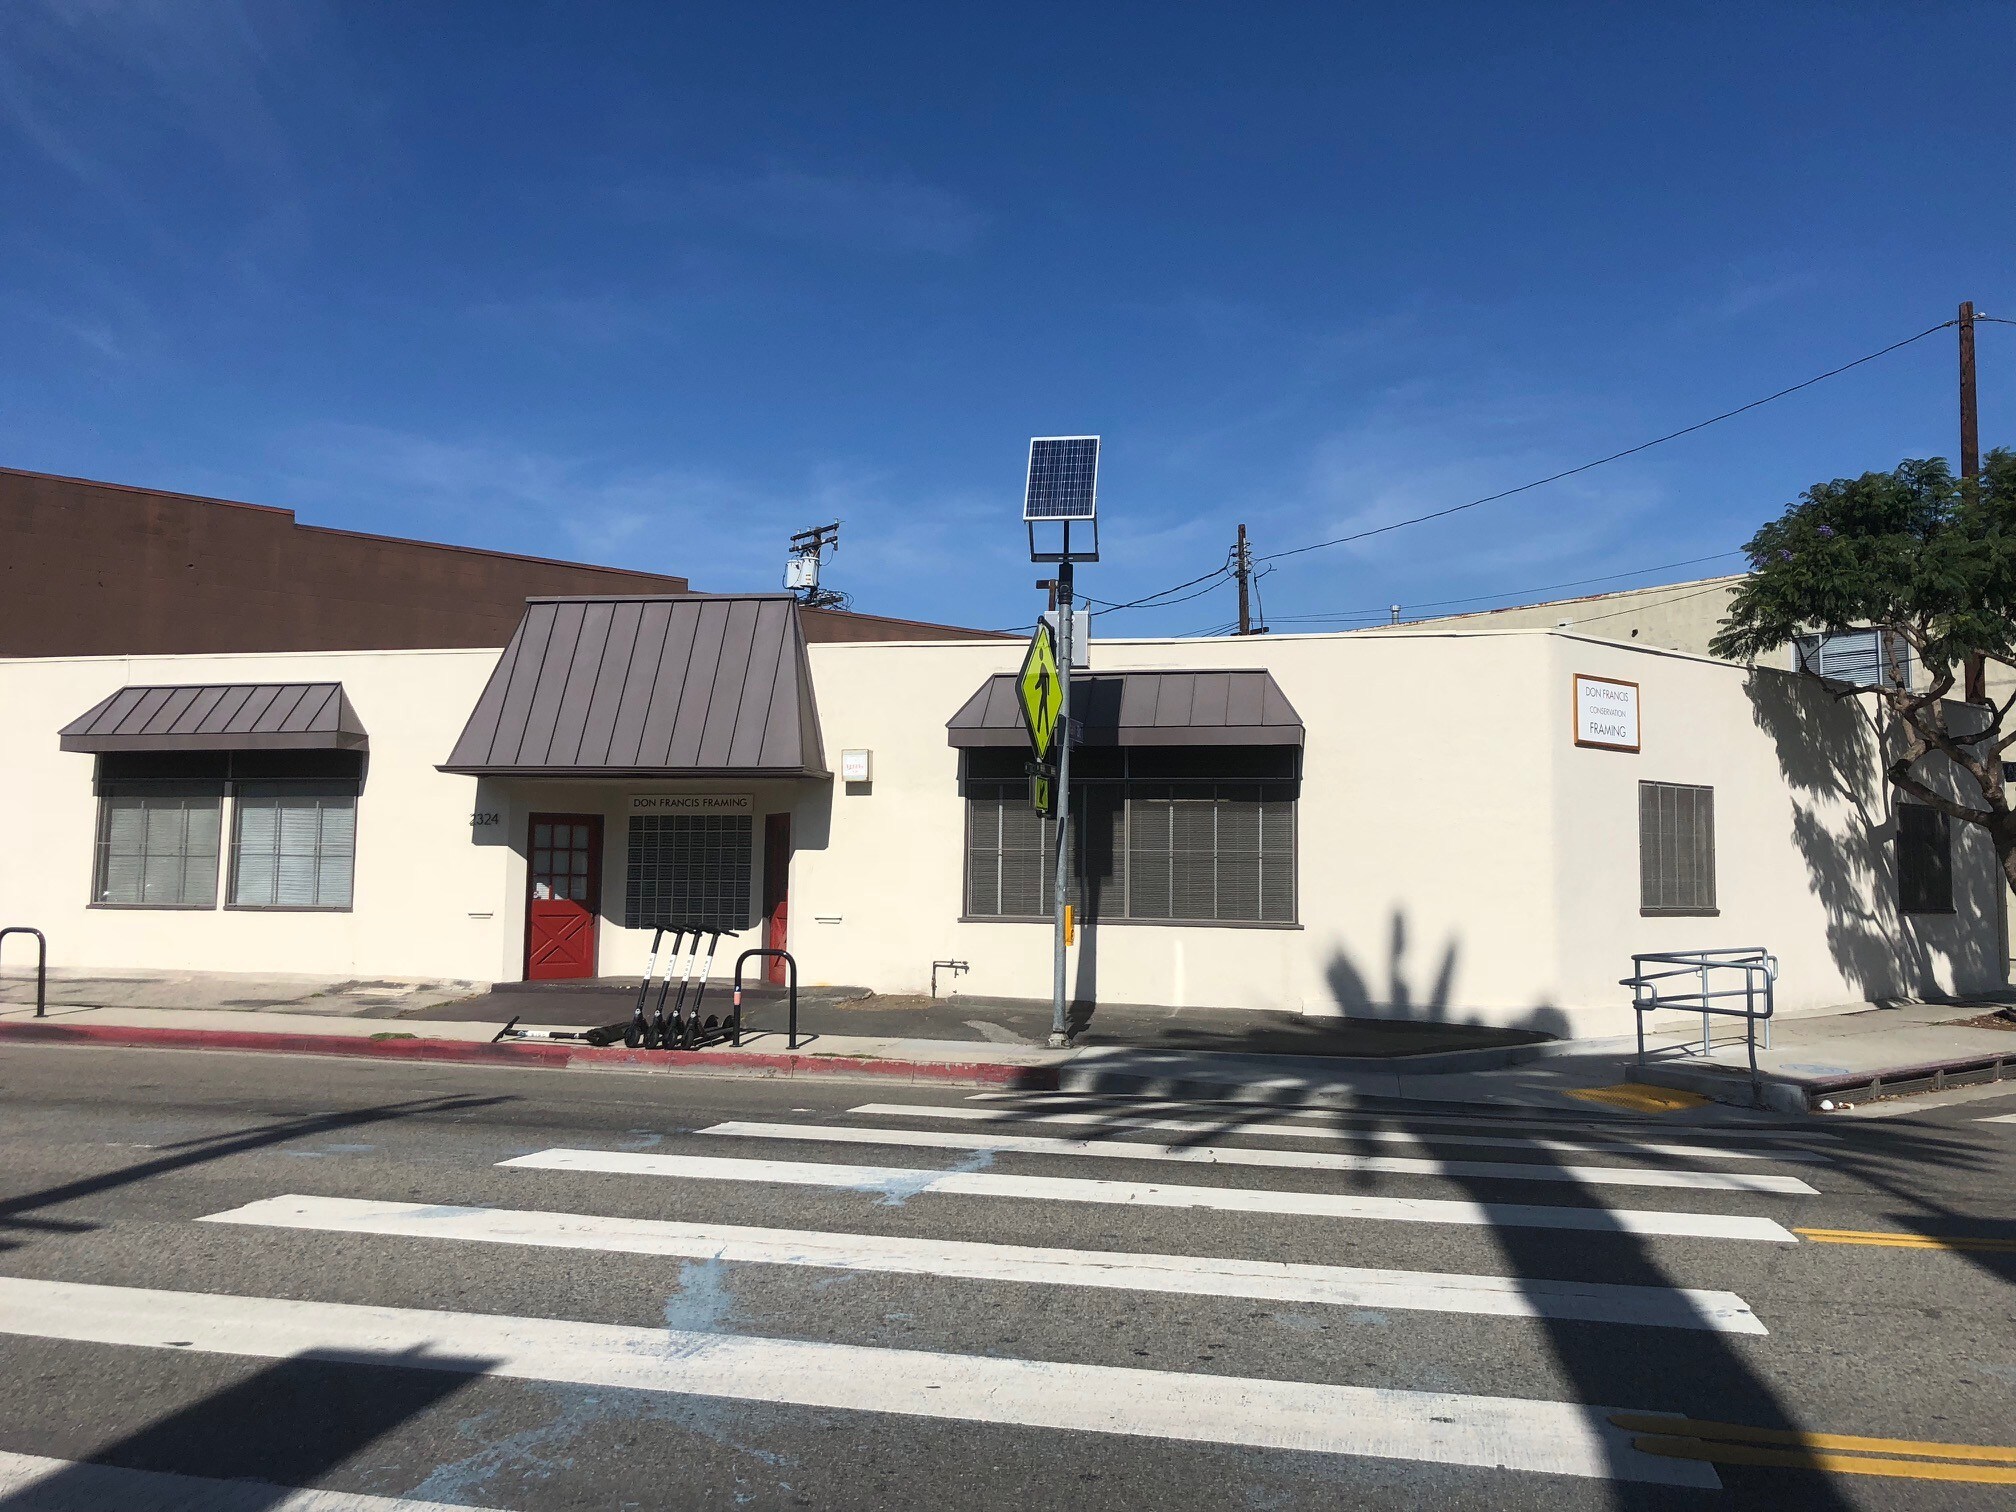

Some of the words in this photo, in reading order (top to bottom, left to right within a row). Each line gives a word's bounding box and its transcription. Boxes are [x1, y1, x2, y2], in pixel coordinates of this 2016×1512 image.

[1585, 686, 1602, 698] DON
[1602, 689, 1629, 702] FRANCIS
[1589, 705, 1627, 718] CONSERVATION
[1589, 721, 1627, 738] FRAMING
[633, 798, 656, 807] DON
[659, 798, 700, 808] FRANCIS
[702, 798, 748, 807] FRAMING
[469, 813, 499, 827] 2324
